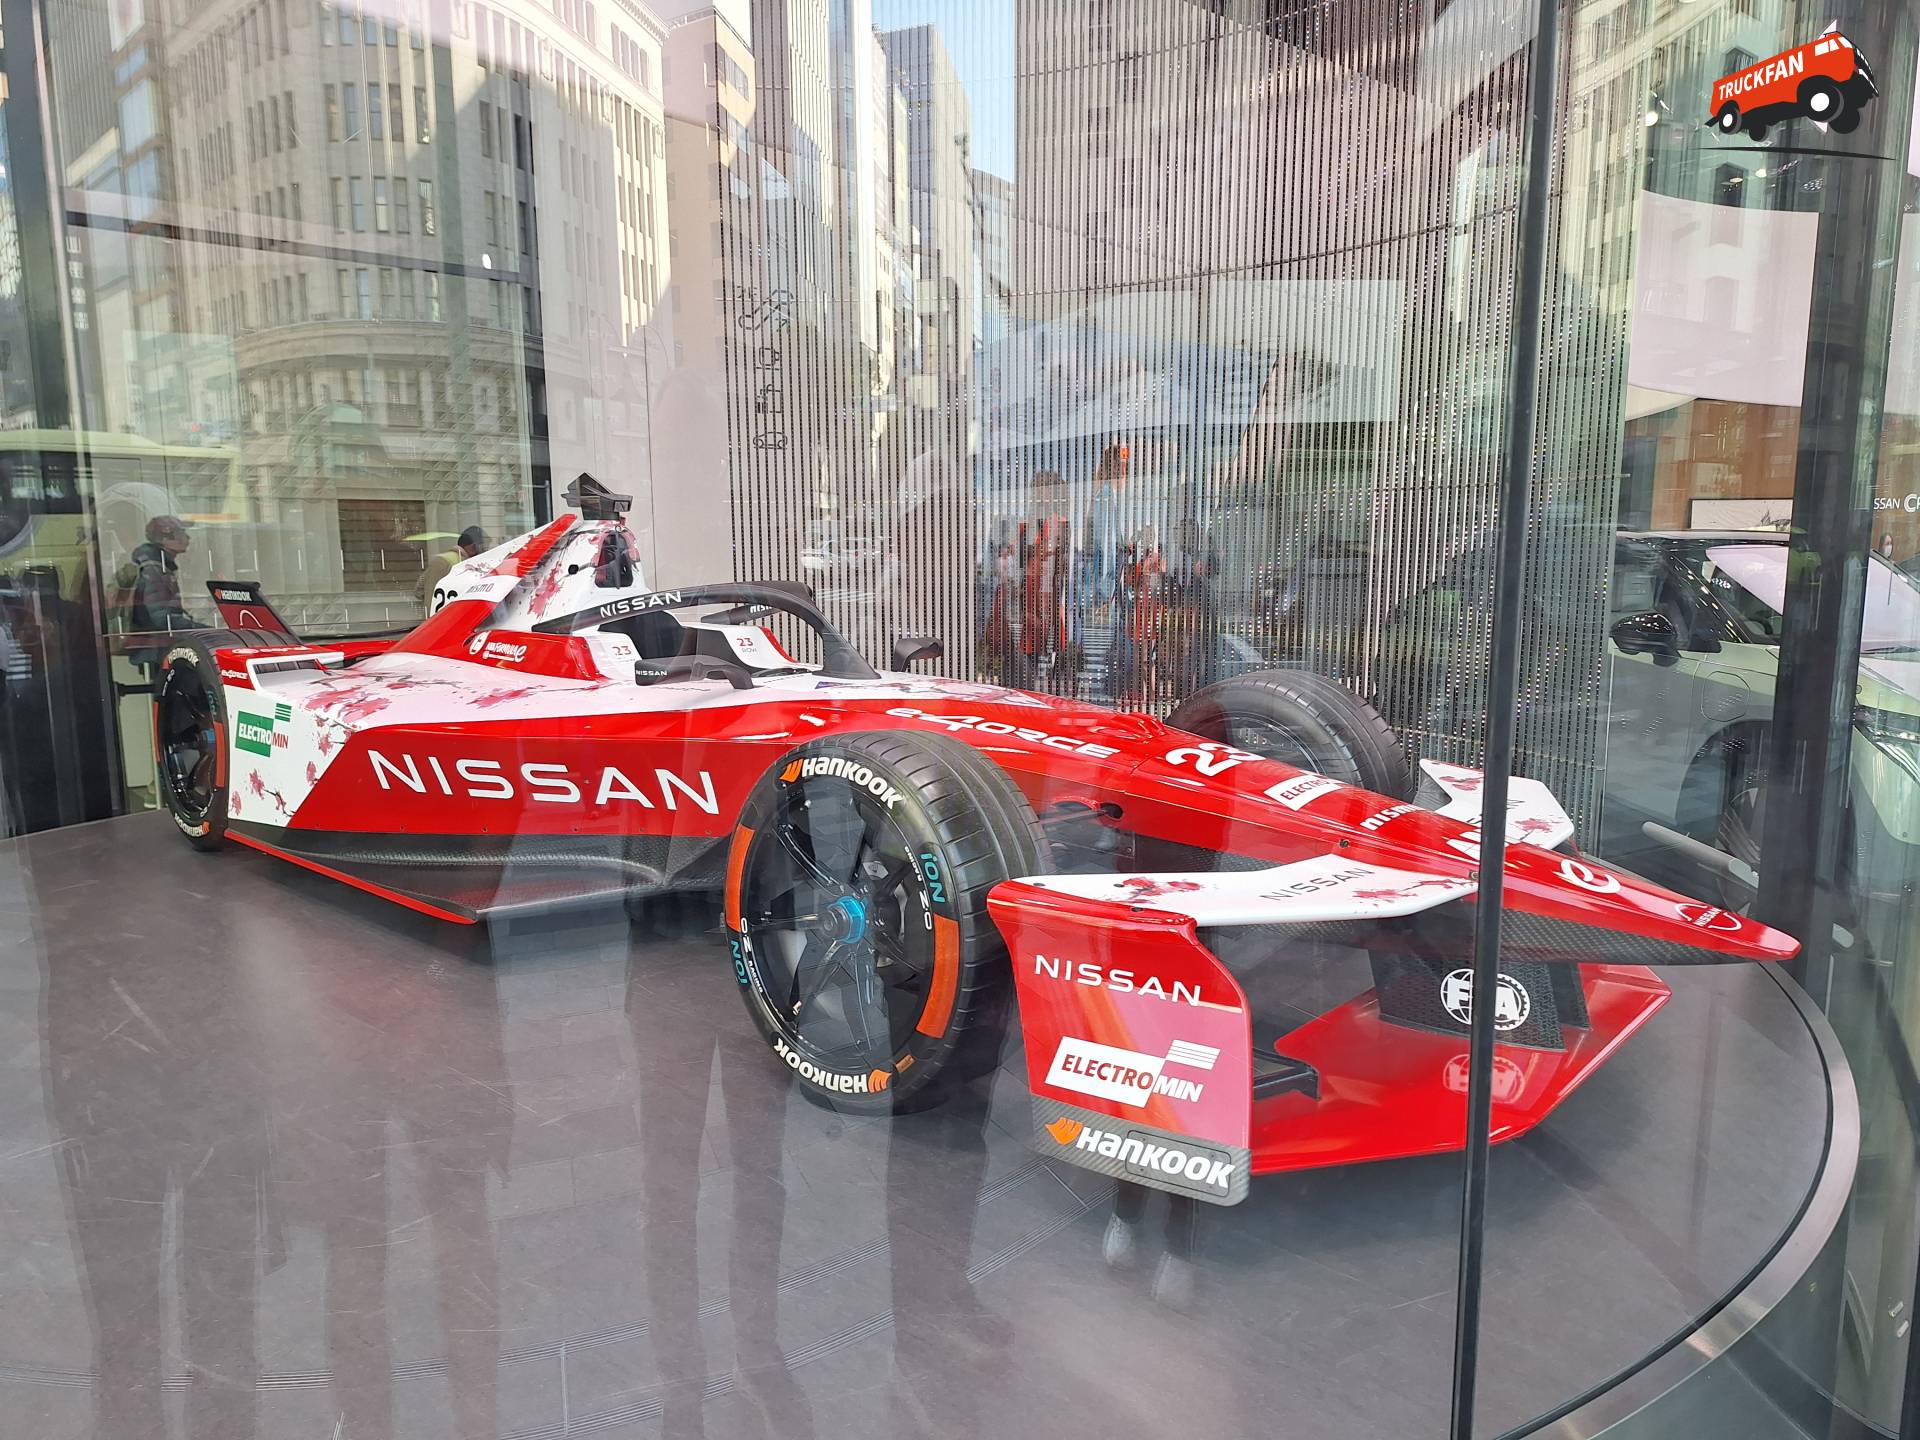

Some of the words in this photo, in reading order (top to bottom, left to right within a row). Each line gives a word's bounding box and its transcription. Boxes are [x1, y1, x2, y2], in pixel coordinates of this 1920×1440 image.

[600, 591, 682, 618] NISSAN
[612, 645, 632, 656] 23
[736, 637, 754, 647] 23
[1165, 742, 1267, 777] 23
[367, 750, 720, 815] NISSAN
[1259, 868, 1375, 901] NISSAN
[1034, 955, 1201, 1007] NISSAN
[1061, 1054, 1204, 1103] ELECTROMIN
